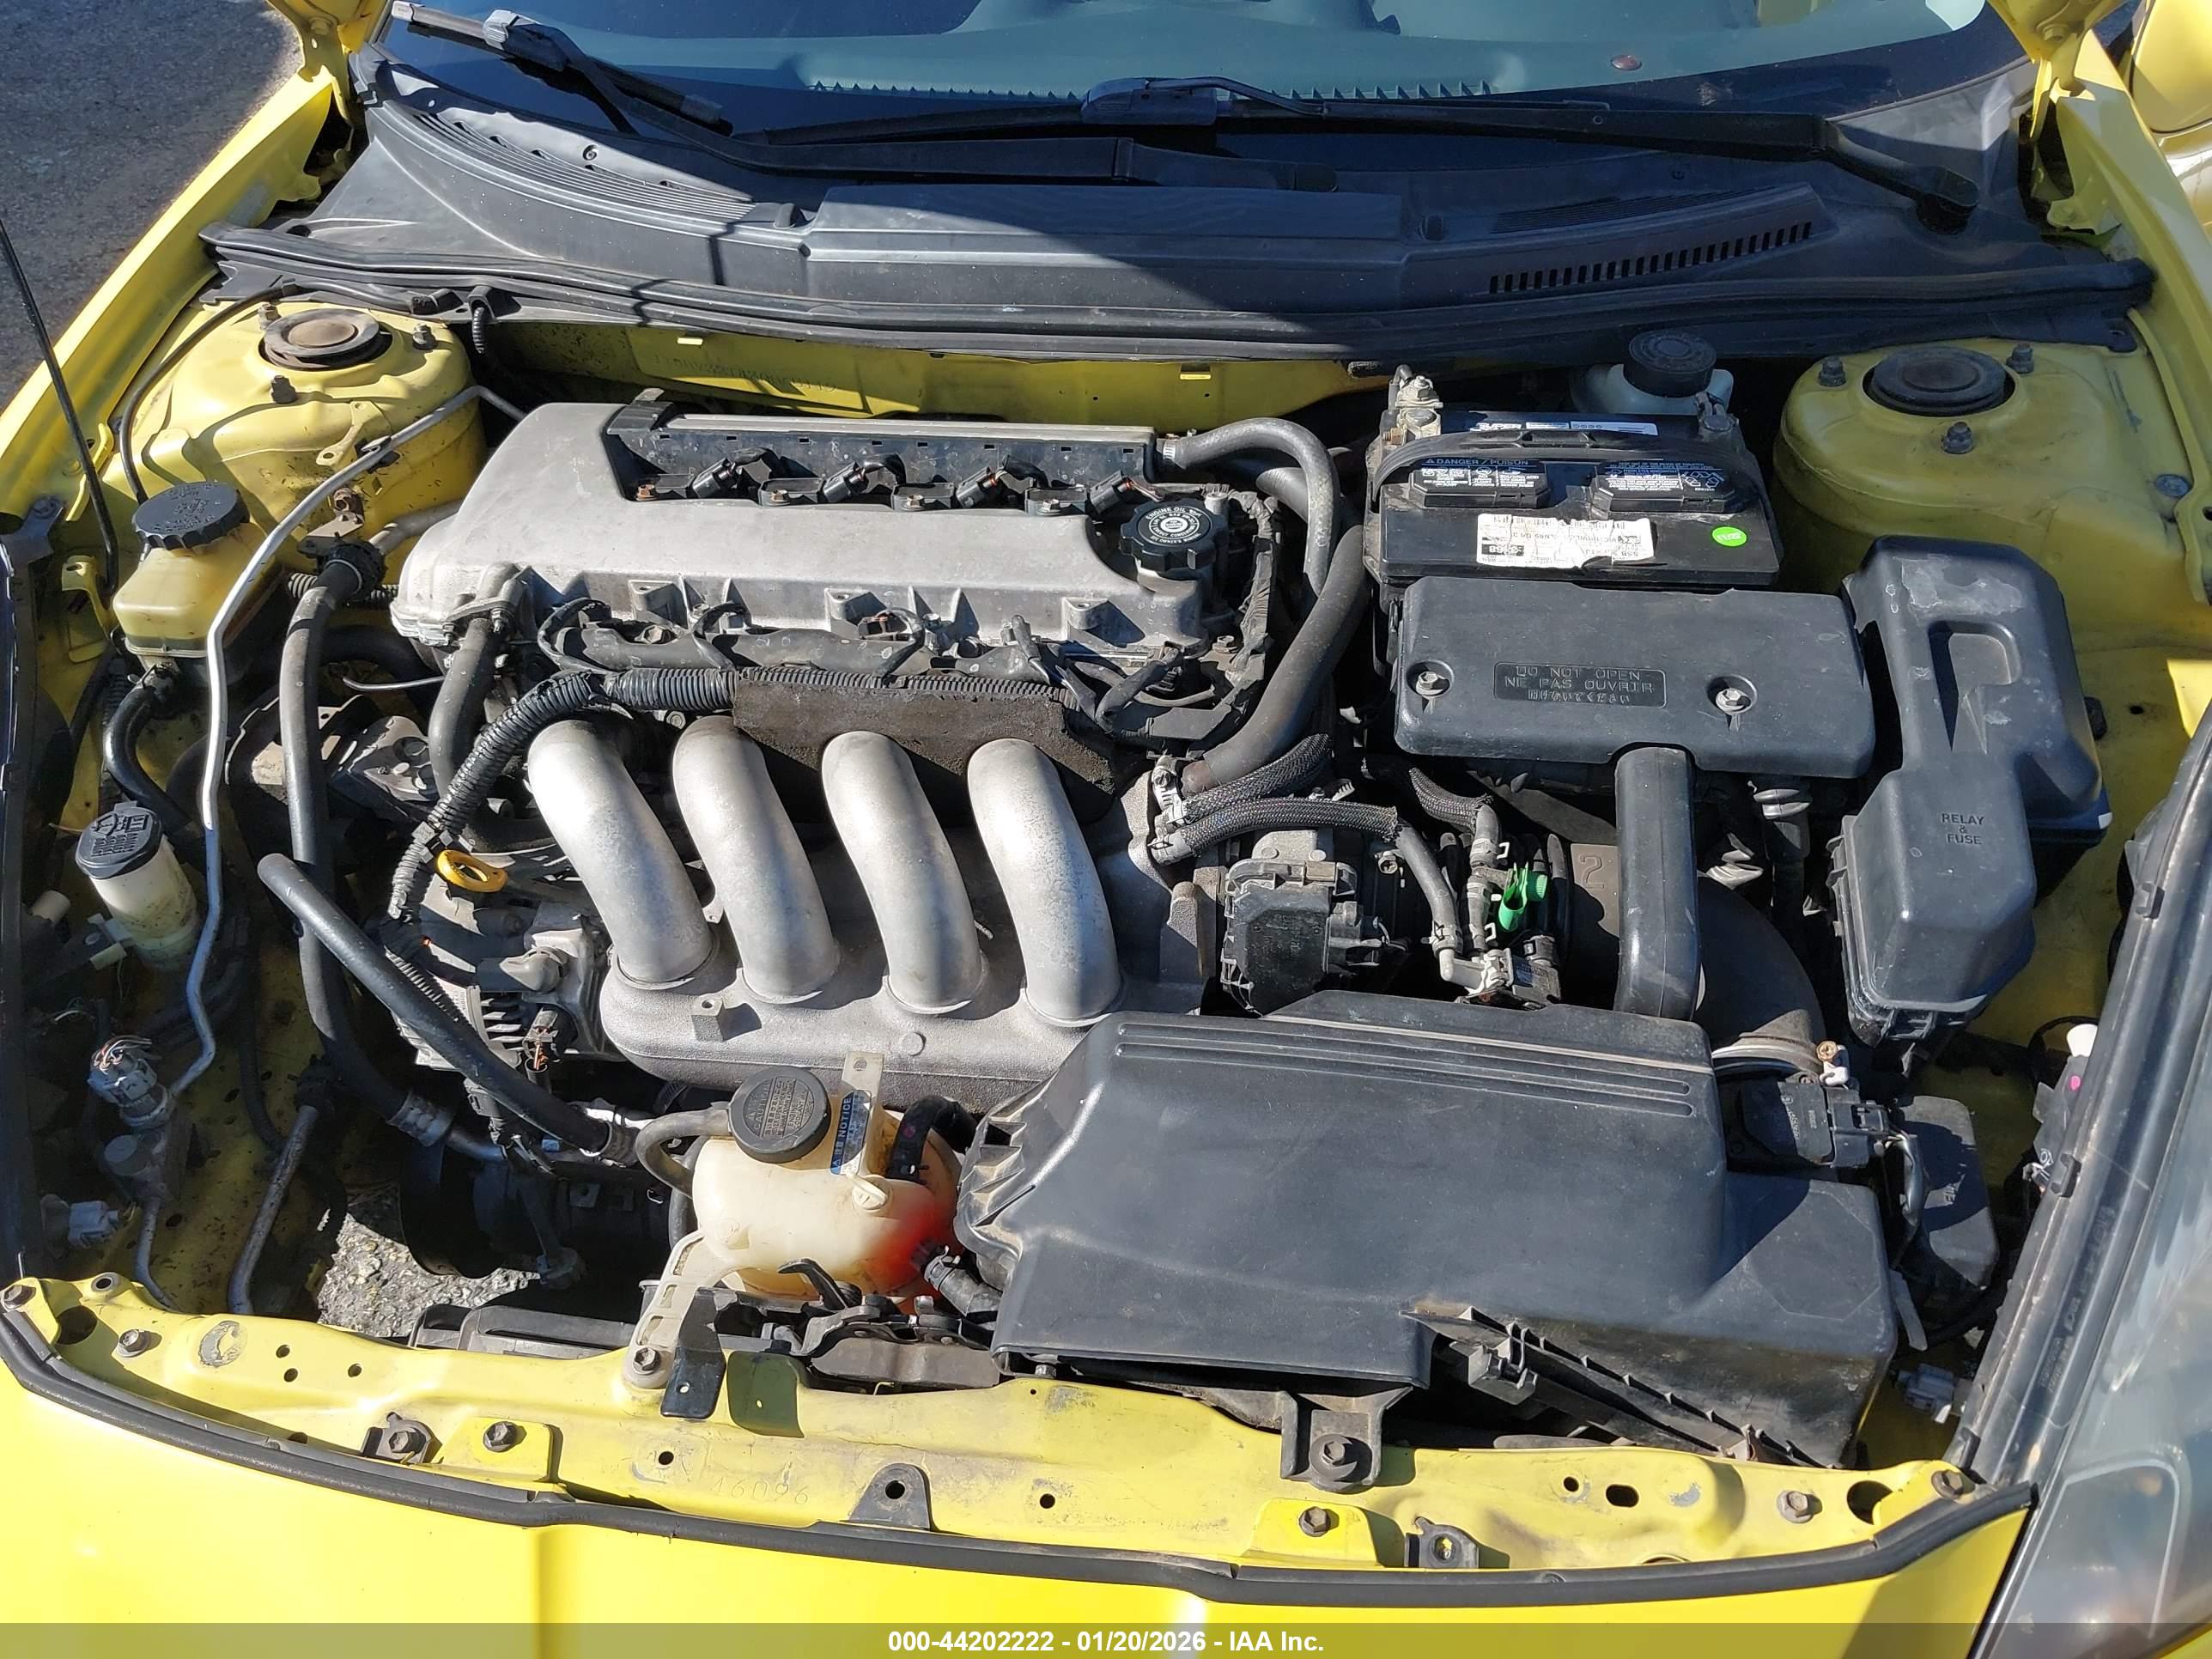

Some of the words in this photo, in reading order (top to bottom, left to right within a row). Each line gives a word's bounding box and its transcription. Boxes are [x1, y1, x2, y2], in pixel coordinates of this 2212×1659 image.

[1146, 507, 1172, 520] ENGINE
[1516, 666, 1539, 678] DO
[1550, 667, 1580, 678] NOT
[1595, 669, 1641, 681] OPEN
[1504, 677, 1527, 689] NE
[1540, 678, 1573, 690] PAS
[1584, 680, 1656, 694] OUVRIR
[1942, 813, 1984, 825] RELAY
[1959, 824, 1968, 835] &
[1948, 833, 1982, 845] FUSE
[755, 1083, 770, 1129] CAUTION
[787, 1103, 799, 1128] ENGINE
[793, 1101, 805, 1129] COOLANT
[840, 1098, 851, 1138] NOTICE
